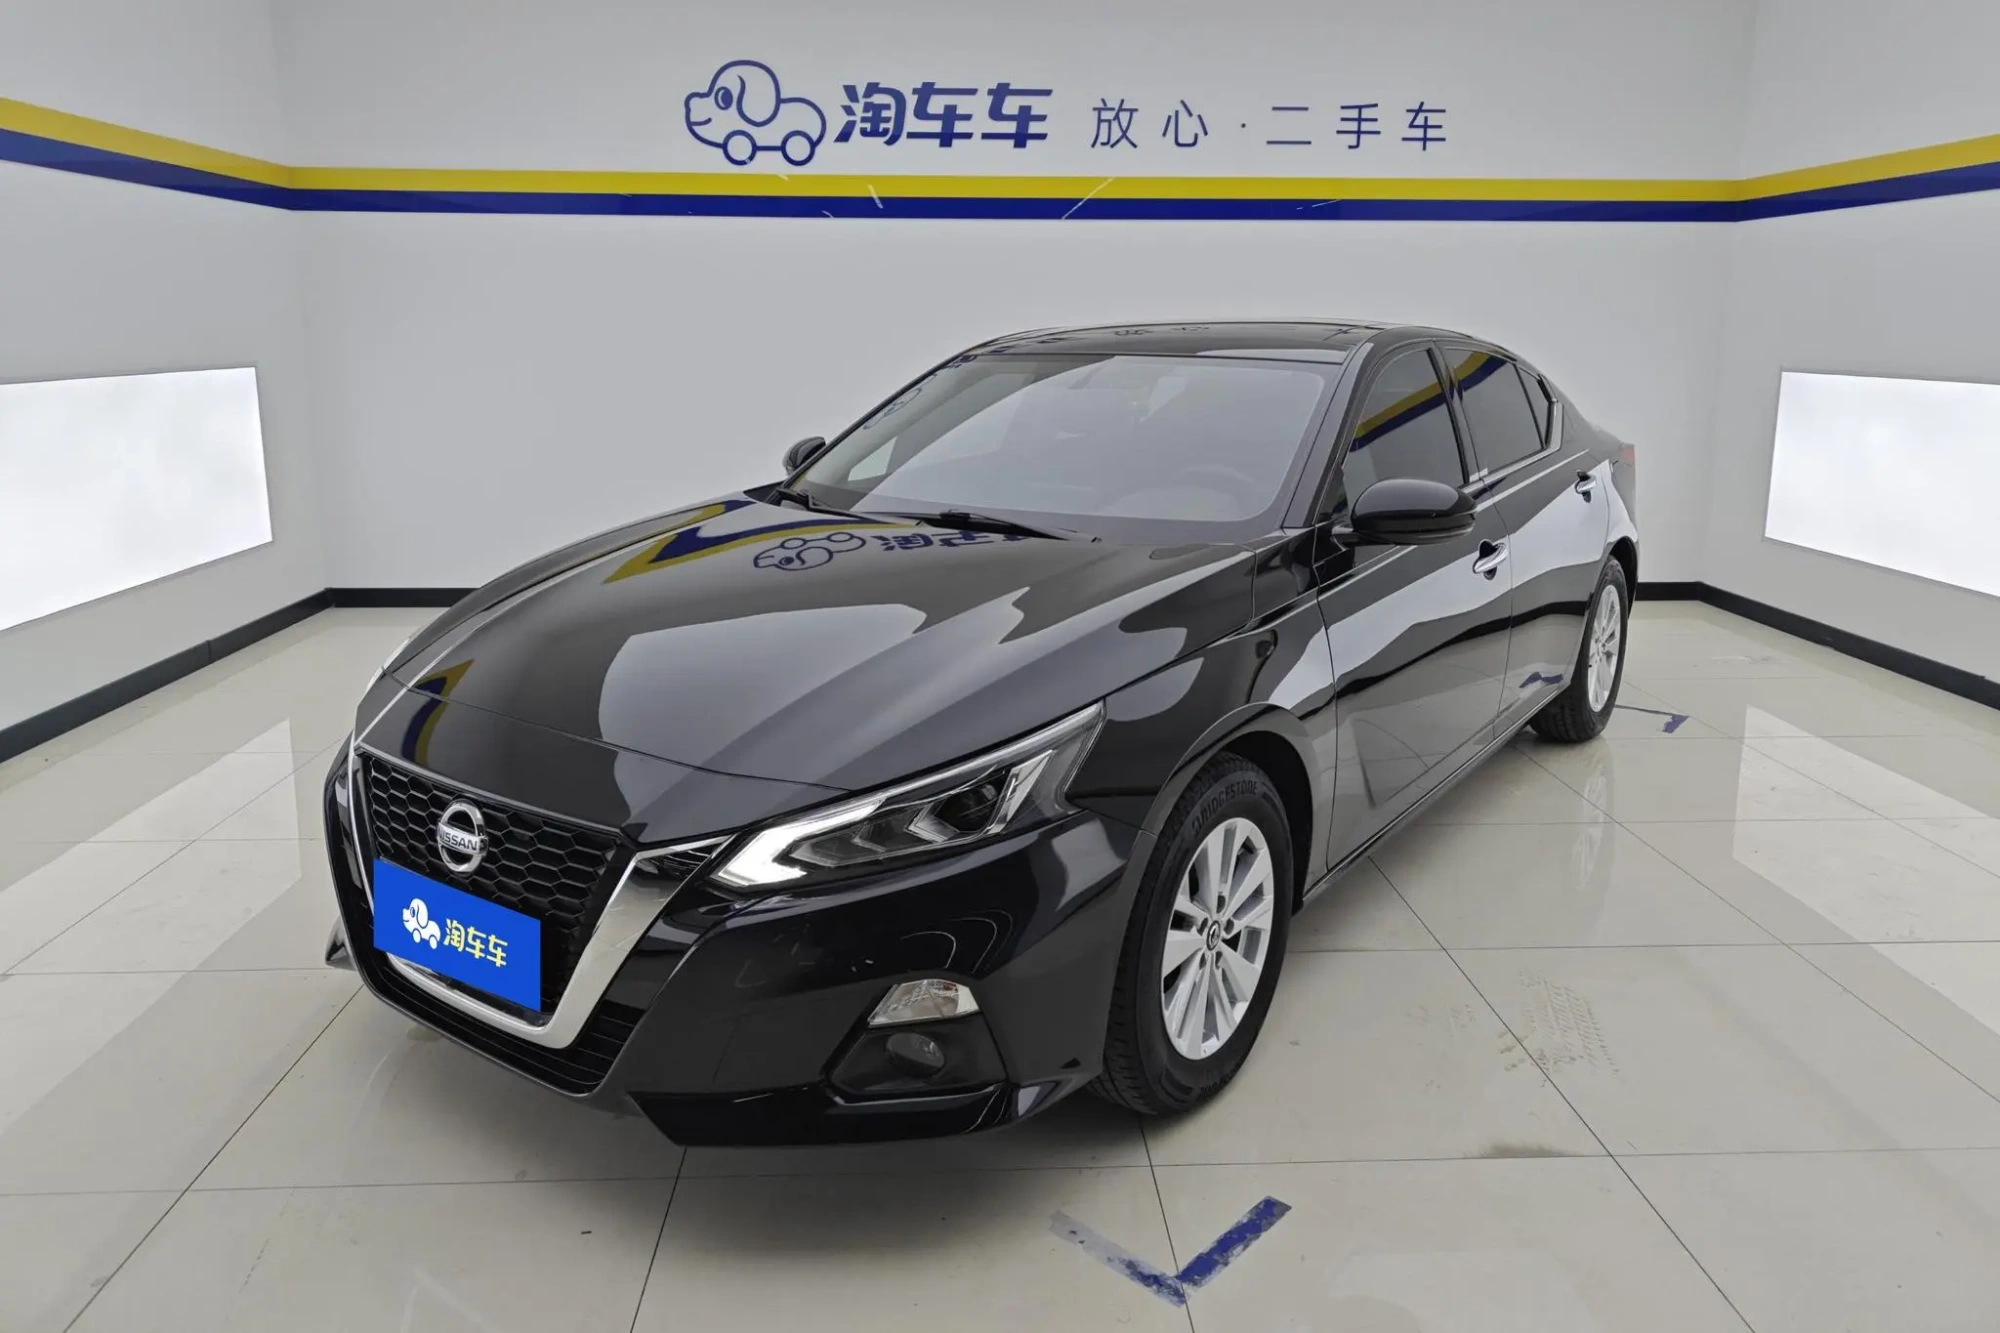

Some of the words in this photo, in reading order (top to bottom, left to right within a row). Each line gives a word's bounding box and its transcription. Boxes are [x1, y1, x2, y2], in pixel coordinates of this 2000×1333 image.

[833, 81, 1053, 149] 淘车车
[438, 826, 478, 851] NISSAN
